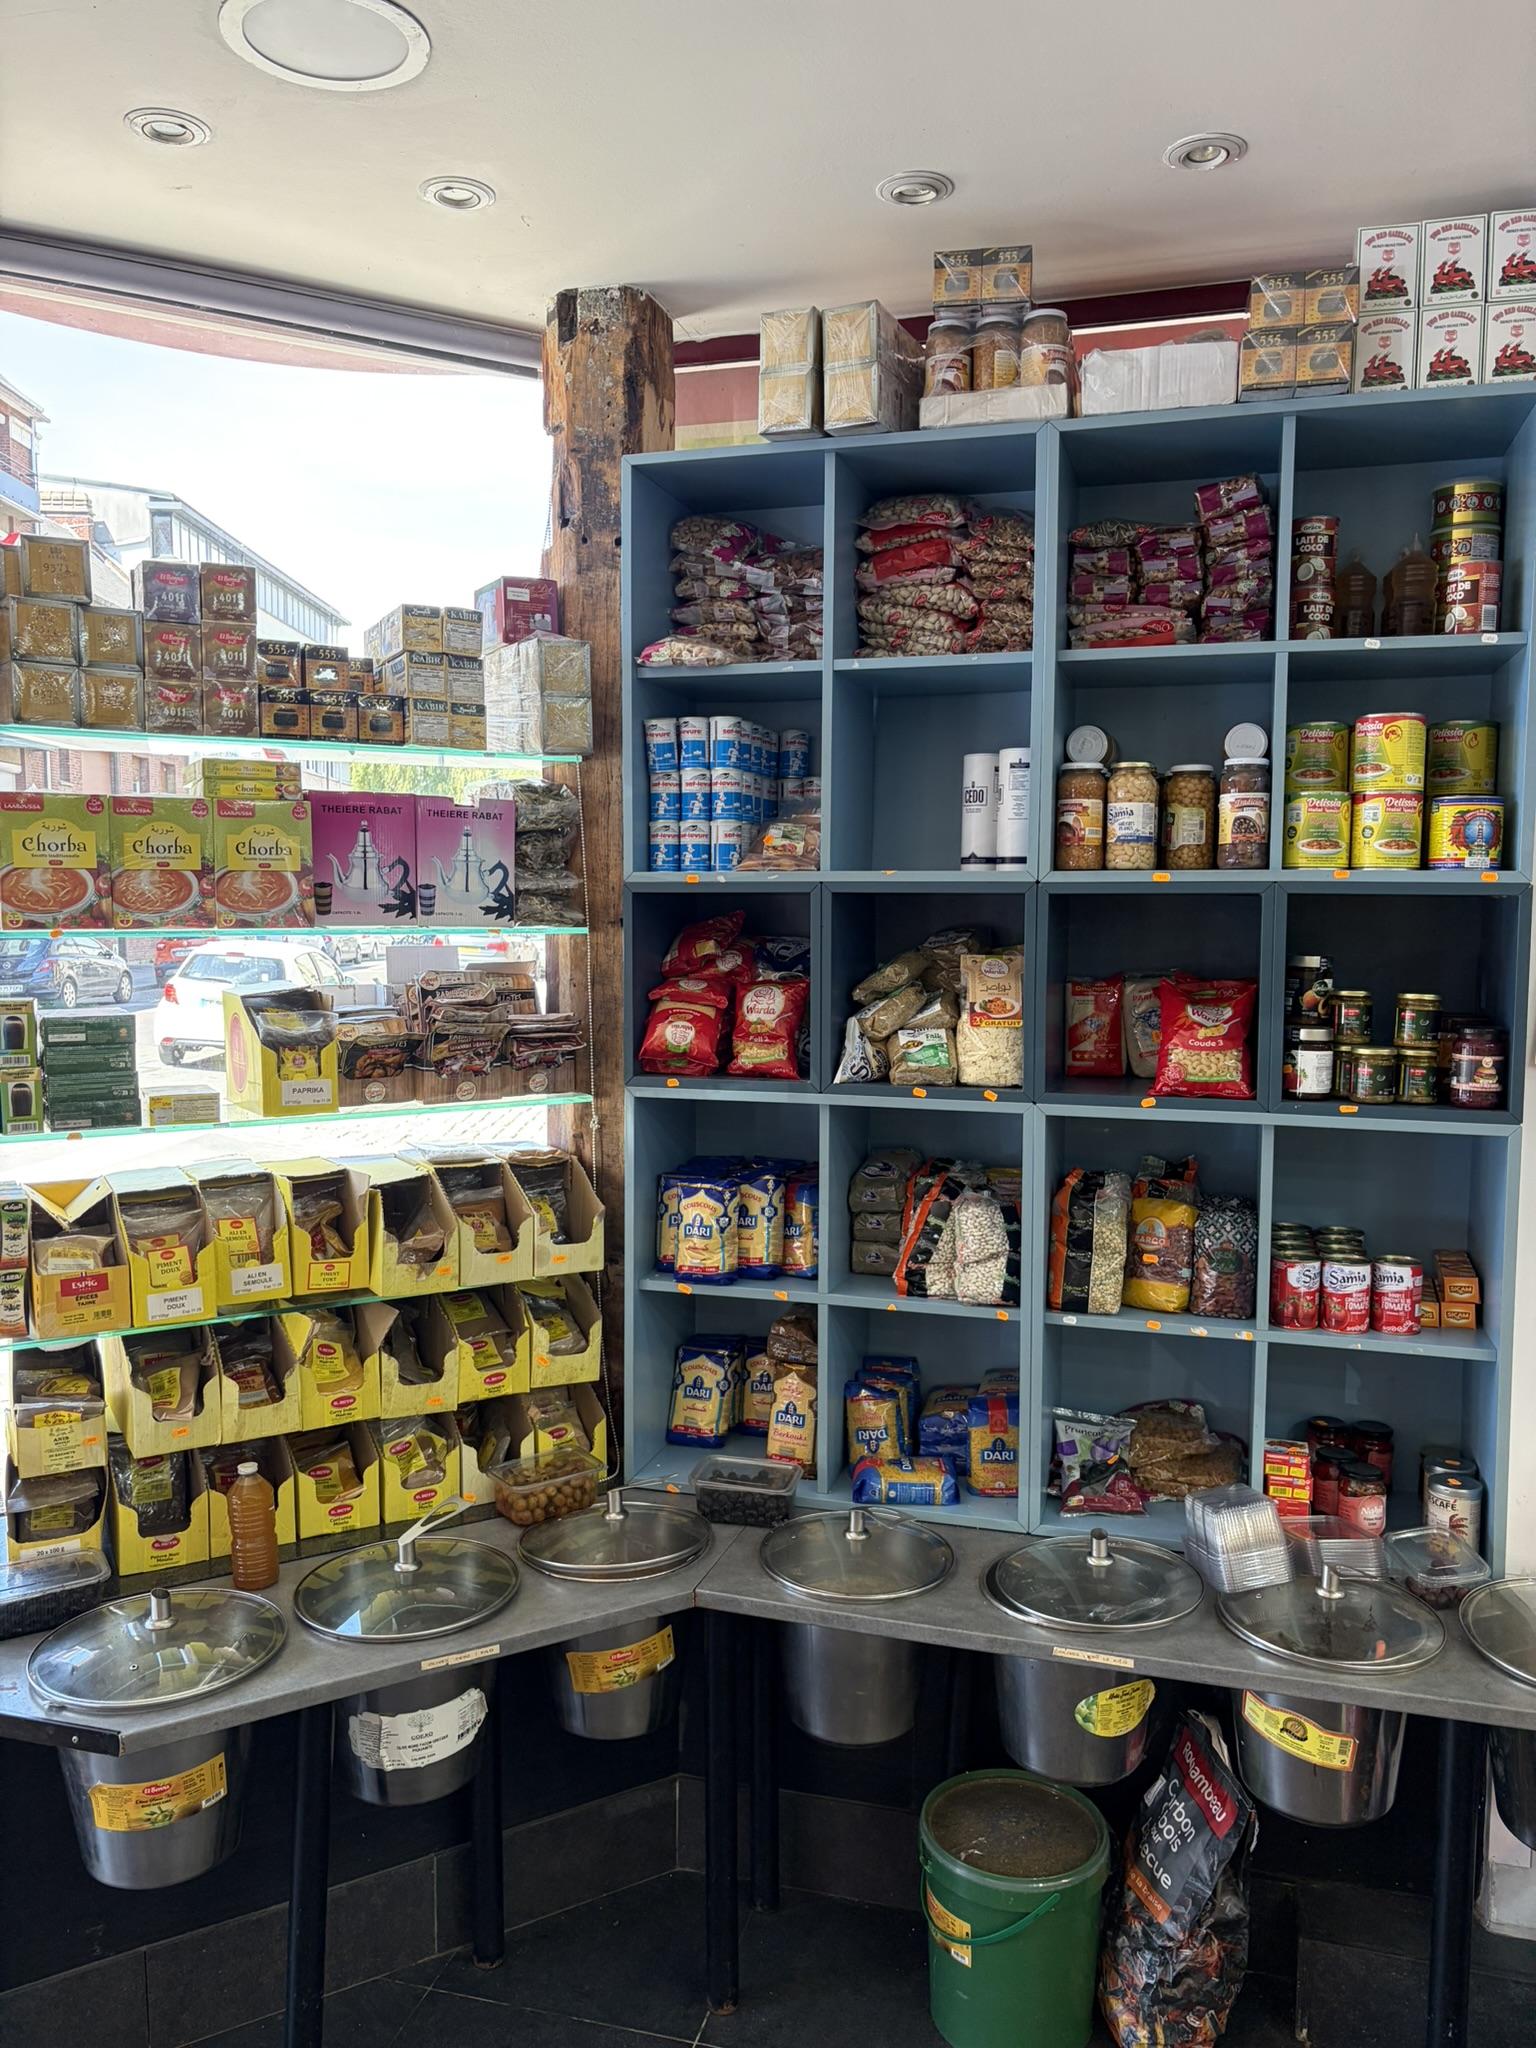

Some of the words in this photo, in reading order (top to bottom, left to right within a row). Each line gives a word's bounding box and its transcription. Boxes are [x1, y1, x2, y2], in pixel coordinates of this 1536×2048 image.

[1322, 273, 1344, 285] 555
[1314, 330, 1336, 342] 555
[1296, 535, 1316, 545] LAIT
[1299, 543, 1324, 553] COCO
[161, 592, 184, 602] 4011
[1304, 604, 1324, 613] LAIT
[450, 610, 479, 622] KABIR
[1308, 612, 1330, 621] COCO
[268, 643, 288, 656] 555
[318, 648, 336, 661] 555
[164, 652, 186, 662] 4011
[412, 653, 442, 666] KABIR
[450, 658, 480, 670] KABIR
[416, 700, 445, 712] KABIR
[164, 707, 186, 718] 4011
[234, 784, 264, 794] Chorba
[1306, 797, 1342, 808] Delissia
[1384, 797, 1418, 808] Delissia
[320, 804, 366, 815] THEIERE
[368, 805, 404, 816] RABAT
[426, 808, 470, 820] THEIERE
[472, 810, 504, 822] RABAT
[22, 834, 88, 853] Chorba
[132, 836, 193, 856] Chorba
[234, 838, 294, 858] Chorba
[746, 1004, 776, 1016] Warda
[1188, 1039, 1216, 1048] Coude
[1216, 1038, 1224, 1047] 3
[291, 1086, 325, 1096] PAPRIKA
[682, 1201, 718, 1214] COUSCOUS
[685, 1225, 710, 1237] DARI
[784, 1225, 800, 1236] ARI
[156, 1258, 182, 1270] PIMENT
[160, 1266, 182, 1276] DOUX
[1329, 1268, 1367, 1284] Samia
[71, 1280, 98, 1290] ESPIG
[242, 1276, 274, 1287] SEMOULE
[163, 1294, 188, 1304] PIMENT
[166, 1302, 186, 1311] DOUX
[686, 1387, 710, 1399] DARI
[777, 1413, 804, 1426] DARI
[857, 1428, 887, 1441] DARI
[983, 1450, 1014, 1461] DARI
[1158, 1809, 1182, 1854] bois
[1140, 1842, 1172, 1890] ecue
[1142, 1885, 1162, 1912] braise
